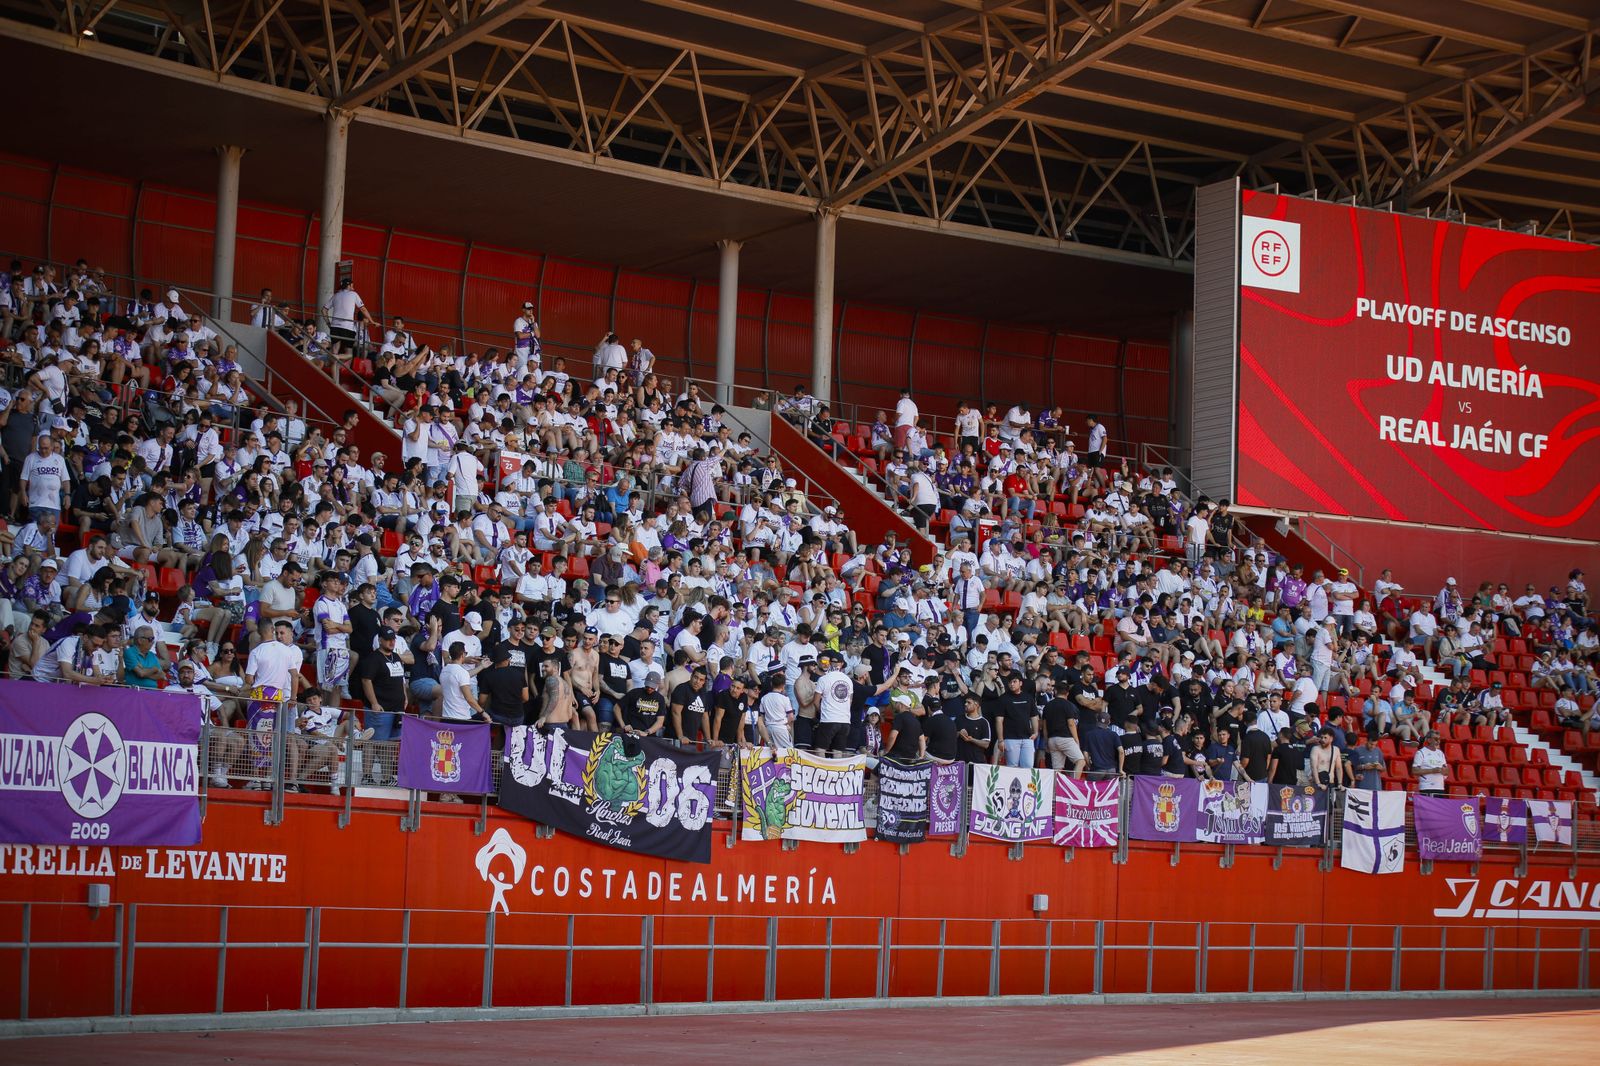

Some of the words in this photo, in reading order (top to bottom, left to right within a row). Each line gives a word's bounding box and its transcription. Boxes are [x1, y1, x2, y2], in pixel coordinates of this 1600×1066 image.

[1356, 297, 1446, 328] PLAYOFF
[1450, 310, 1477, 333] DE
[1480, 315, 1571, 347] ASCENSO
[1386, 354, 1423, 383] UD
[1427, 360, 1544, 399] ALMERÍA
[1458, 401, 1472, 414] VS
[1379, 415, 1446, 447] REAL
[1450, 420, 1512, 455] JAÉN
[1518, 432, 1548, 458] CF
[128, 744, 195, 791] BLANCA
[70, 822, 110, 840] 2009
[973, 813, 1022, 838] YOUNG
[120, 855, 143, 870] DE
[145, 848, 287, 883] LEVANTE
[530, 865, 639, 901] COSTA
[647, 871, 683, 902] DE
[691, 867, 837, 905] ALMERÍA
